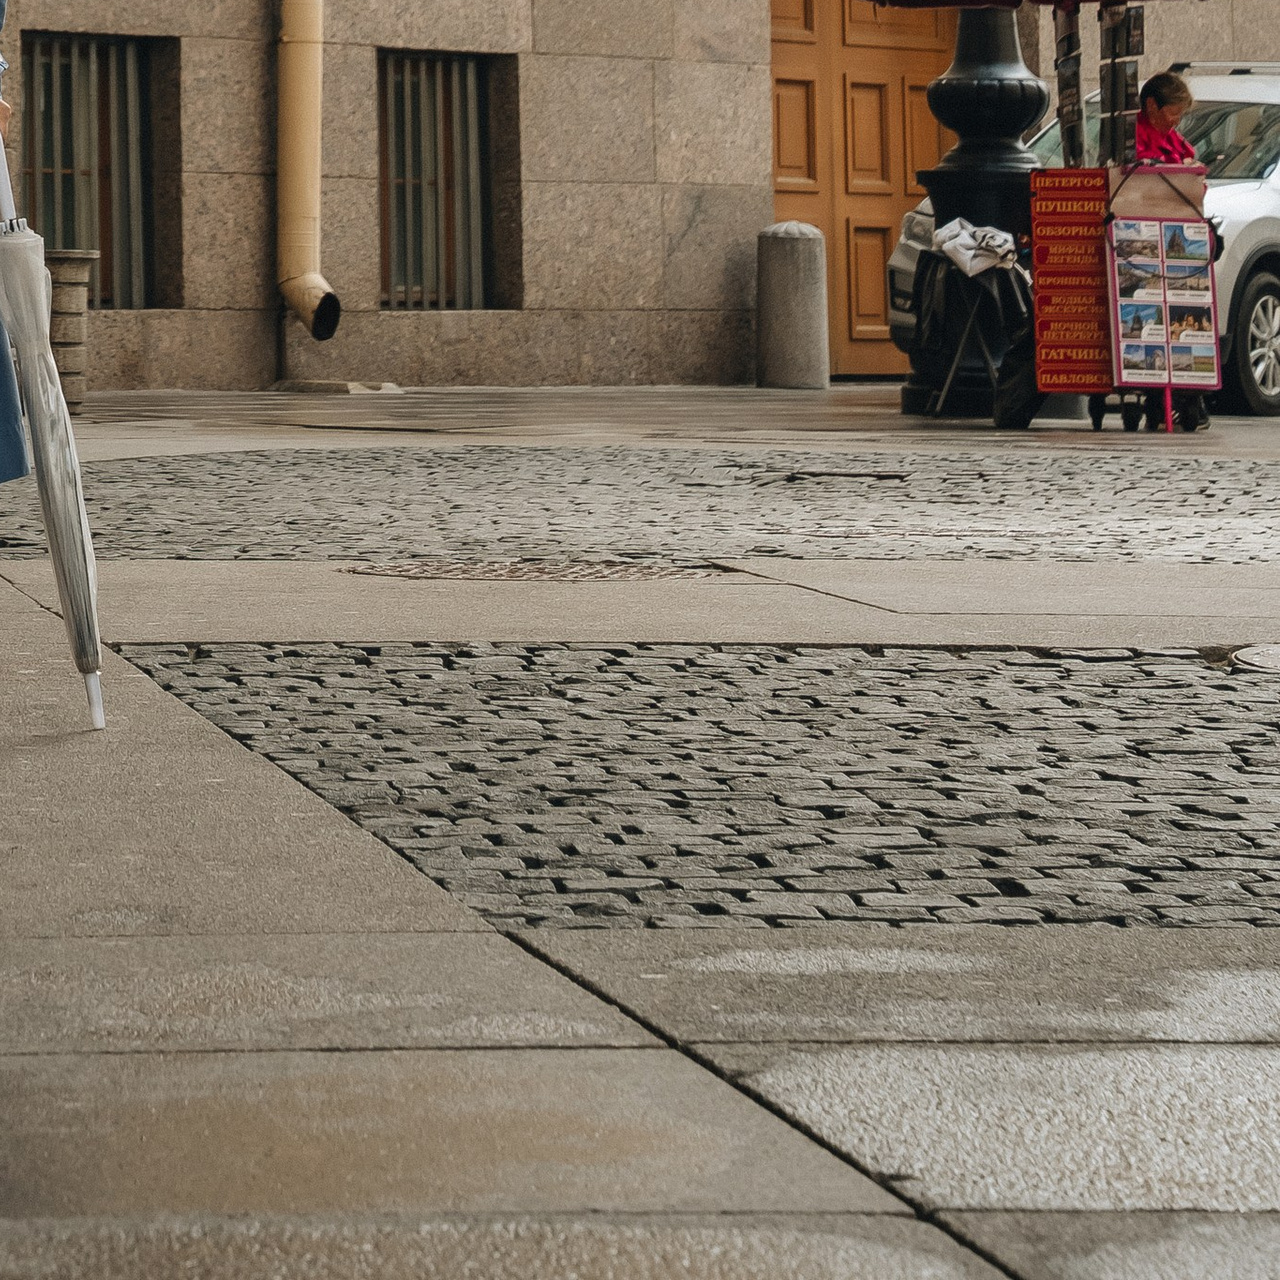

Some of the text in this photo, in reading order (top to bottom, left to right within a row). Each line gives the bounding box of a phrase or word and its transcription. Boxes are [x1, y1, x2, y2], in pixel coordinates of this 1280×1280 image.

[1035, 177, 1104, 188] ПЕТЕРГОФ
[1035, 201, 1106, 212] ПУШКИН
[1041, 348, 1109, 360] ГАТЧИНА
[1041, 374, 1111, 384] ПАВЛОВСК
